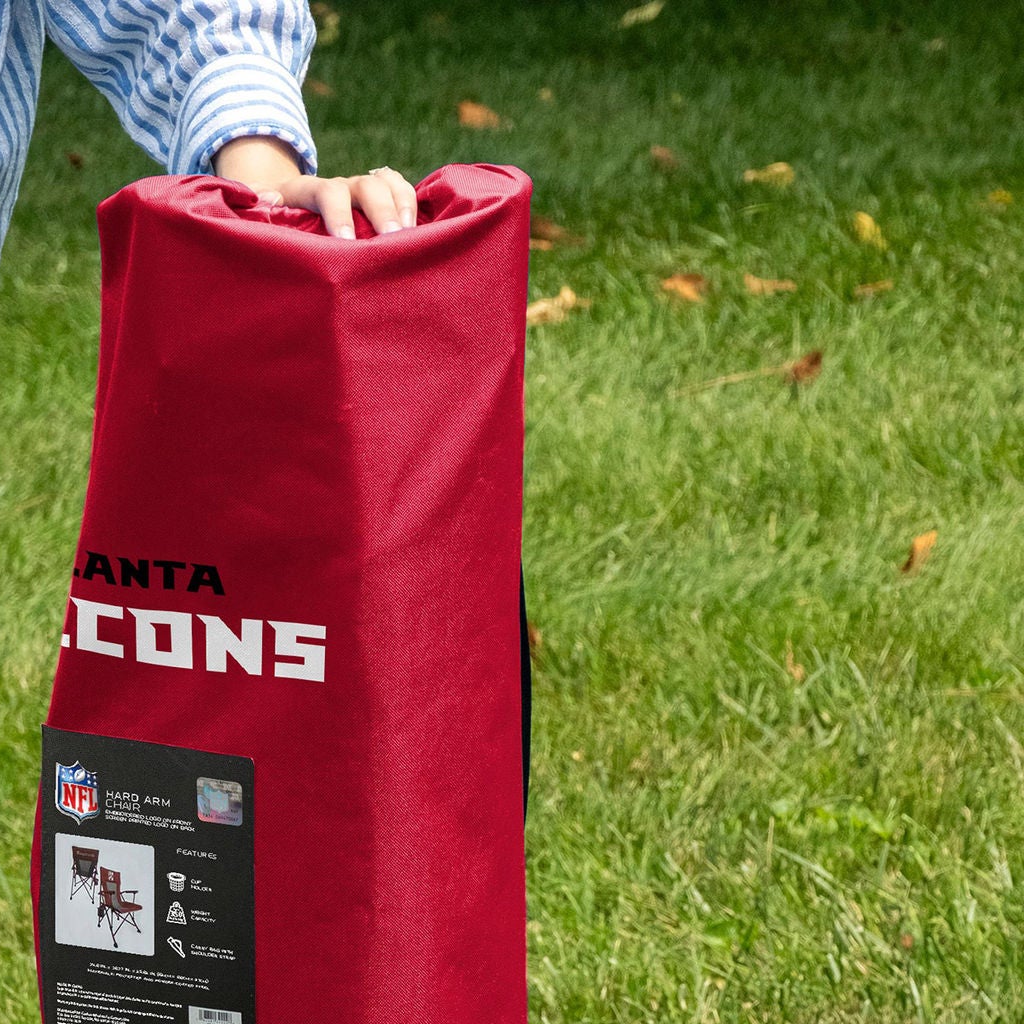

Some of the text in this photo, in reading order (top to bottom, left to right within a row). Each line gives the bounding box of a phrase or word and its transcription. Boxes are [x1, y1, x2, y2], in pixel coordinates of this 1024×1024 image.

[73, 551, 225, 596] ANTA
[61, 596, 326, 682] CONS
[63, 783, 98, 813] NFL
[105, 799, 141, 812] CHAIR
[106, 790, 171, 807] HARD ARM
[128, 818, 152, 826] PRINTED
[177, 848, 217, 860] FEATURES
